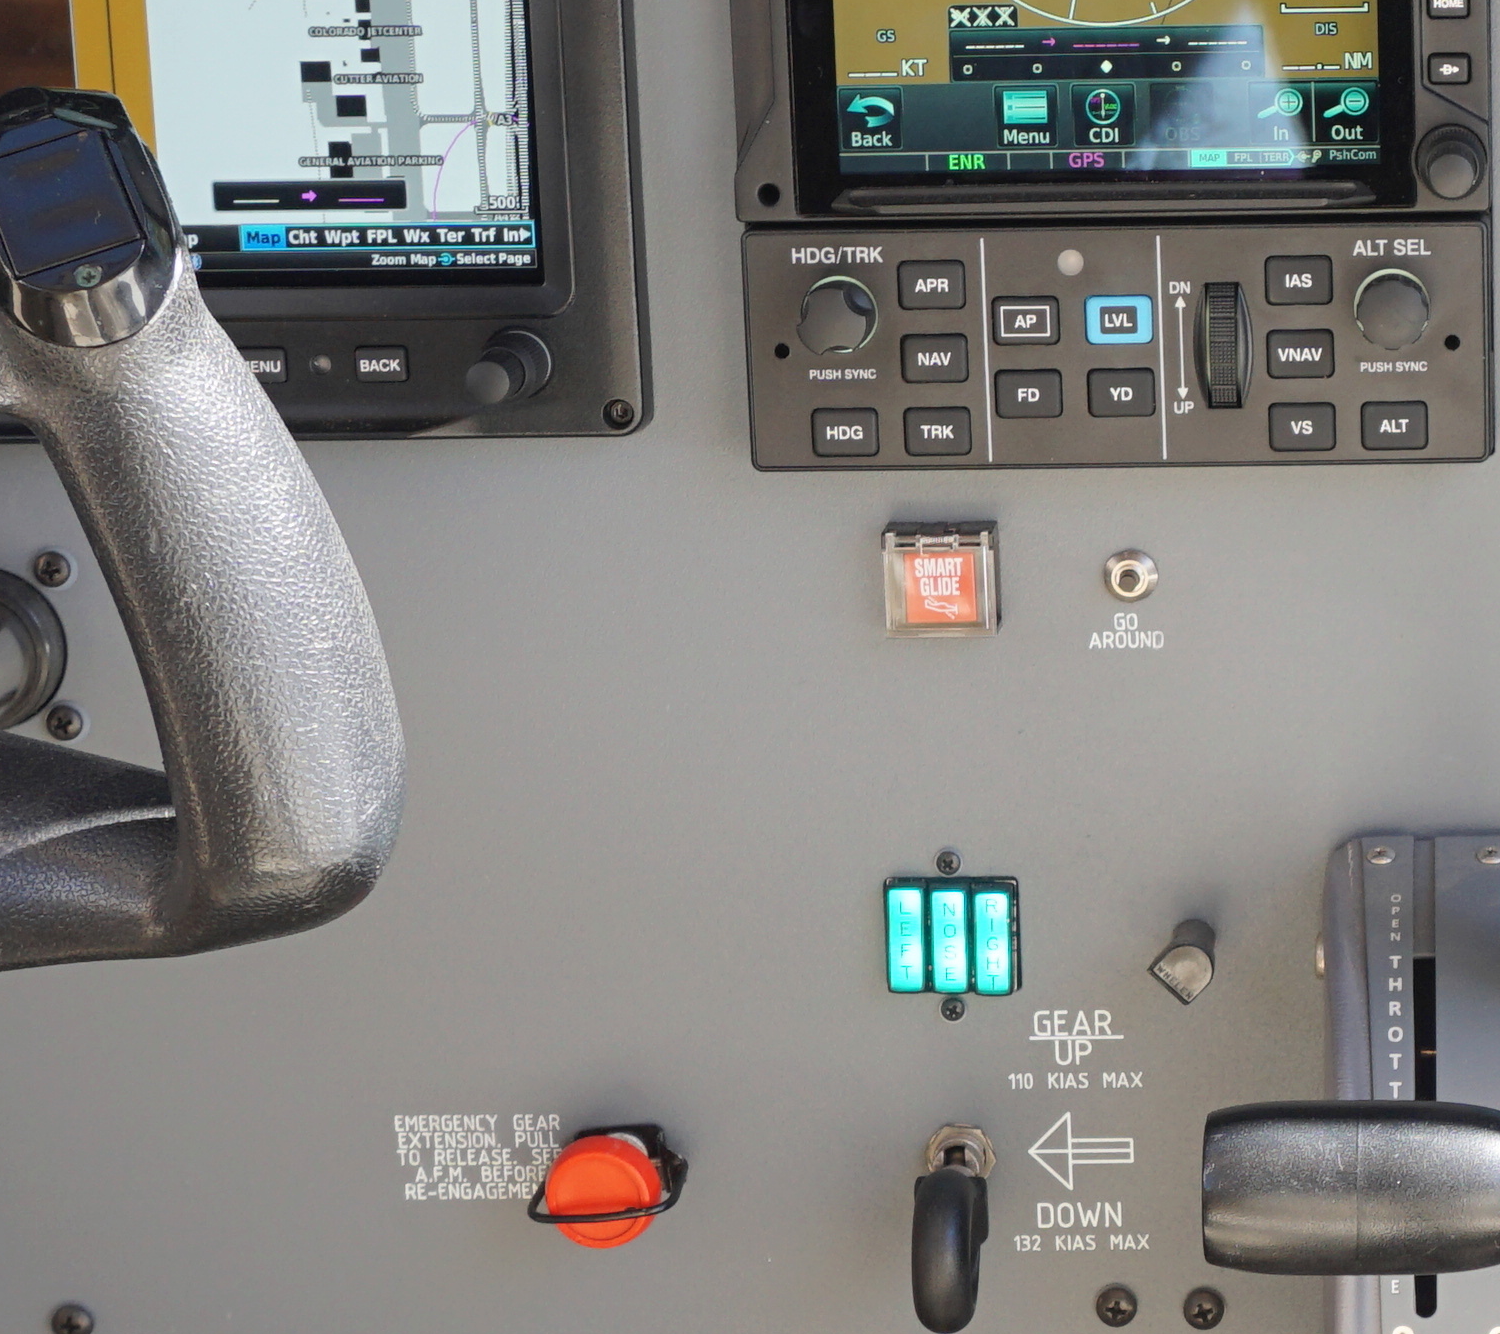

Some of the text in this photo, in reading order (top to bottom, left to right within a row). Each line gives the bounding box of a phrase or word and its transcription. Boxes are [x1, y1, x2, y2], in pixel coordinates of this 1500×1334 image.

[308, 25, 422, 37] COLORADO JETCENTER
[334, 73, 423, 85] CUTTER AVIATION
[851, 130, 892, 147] Back
[1003, 127, 1050, 145] Menu
[1089, 127, 1120, 144] CDI
[1331, 124, 1363, 141] Out
[299, 155, 442, 167] GENERAL AVIATION PARKING
[949, 153, 985, 170] ENR
[1069, 152, 1104, 168] GPS
[246, 227, 496, 247] Map Cht Wpt FPL Wx Ter Trf
[792, 247, 883, 265] HDG/TRK
[1353, 240, 1431, 257] ALT SEL
[915, 278, 949, 294] APR
[1285, 274, 1311, 288] IAS
[1015, 314, 1036, 329] AP
[1105, 313, 1132, 327] LVL
[918, 351, 950, 367] NAV
[1278, 347, 1321, 362] VNAV
[360, 357, 400, 373] BACK
[810, 369, 876, 380] PUSH SYNC
[826, 425, 863, 441] HDG
[921, 425, 954, 440] TRK
[1292, 420, 1312, 435] VS
[1380, 419, 1408, 434] ALT
[914, 557, 962, 579] SMART
[919, 576, 960, 597] GLIDE
[1113, 613, 1138, 630] GO
[1089, 630, 1164, 649] AROUND
[1033, 1010, 1113, 1036] GEAR
[1055, 1041, 1093, 1066] UP
[1008, 1072, 1143, 1090] 110 KIAS MAX
[394, 1114, 560, 1131] EMERGENCY GEAR
[398, 1131, 559, 1149] EXTENSION. PULL
[397, 1149, 517, 1166] TO RELEASE.
[1036, 1202, 1123, 1228] DOWN
[1014, 1234, 1150, 1252] 132 KIAS MAX
